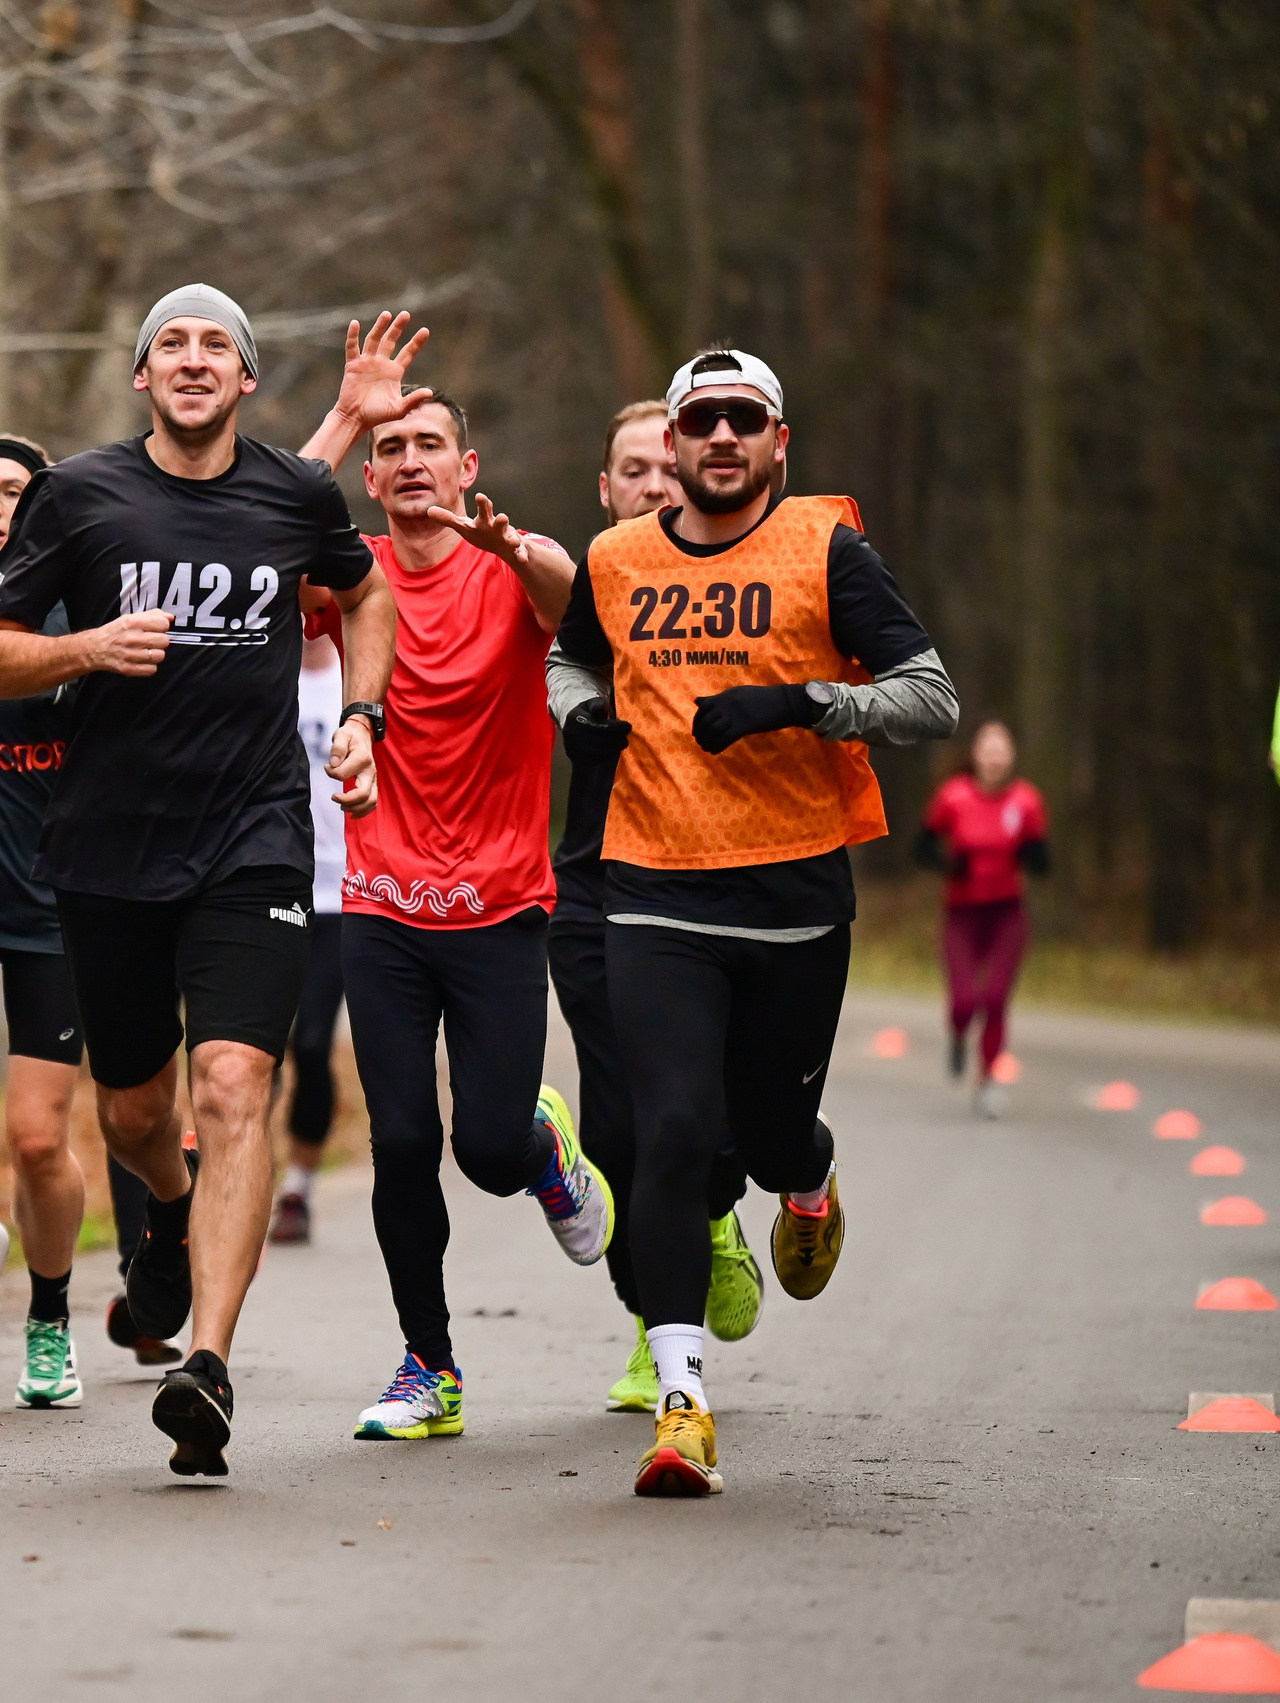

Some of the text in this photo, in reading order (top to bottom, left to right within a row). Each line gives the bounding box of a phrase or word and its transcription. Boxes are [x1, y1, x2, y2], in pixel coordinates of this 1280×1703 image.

[119, 561, 279, 630] M42.2
[629, 582, 772, 641] 22:30
[648, 649, 682, 667] 4:30
[269, 907, 305, 927] PUMA
